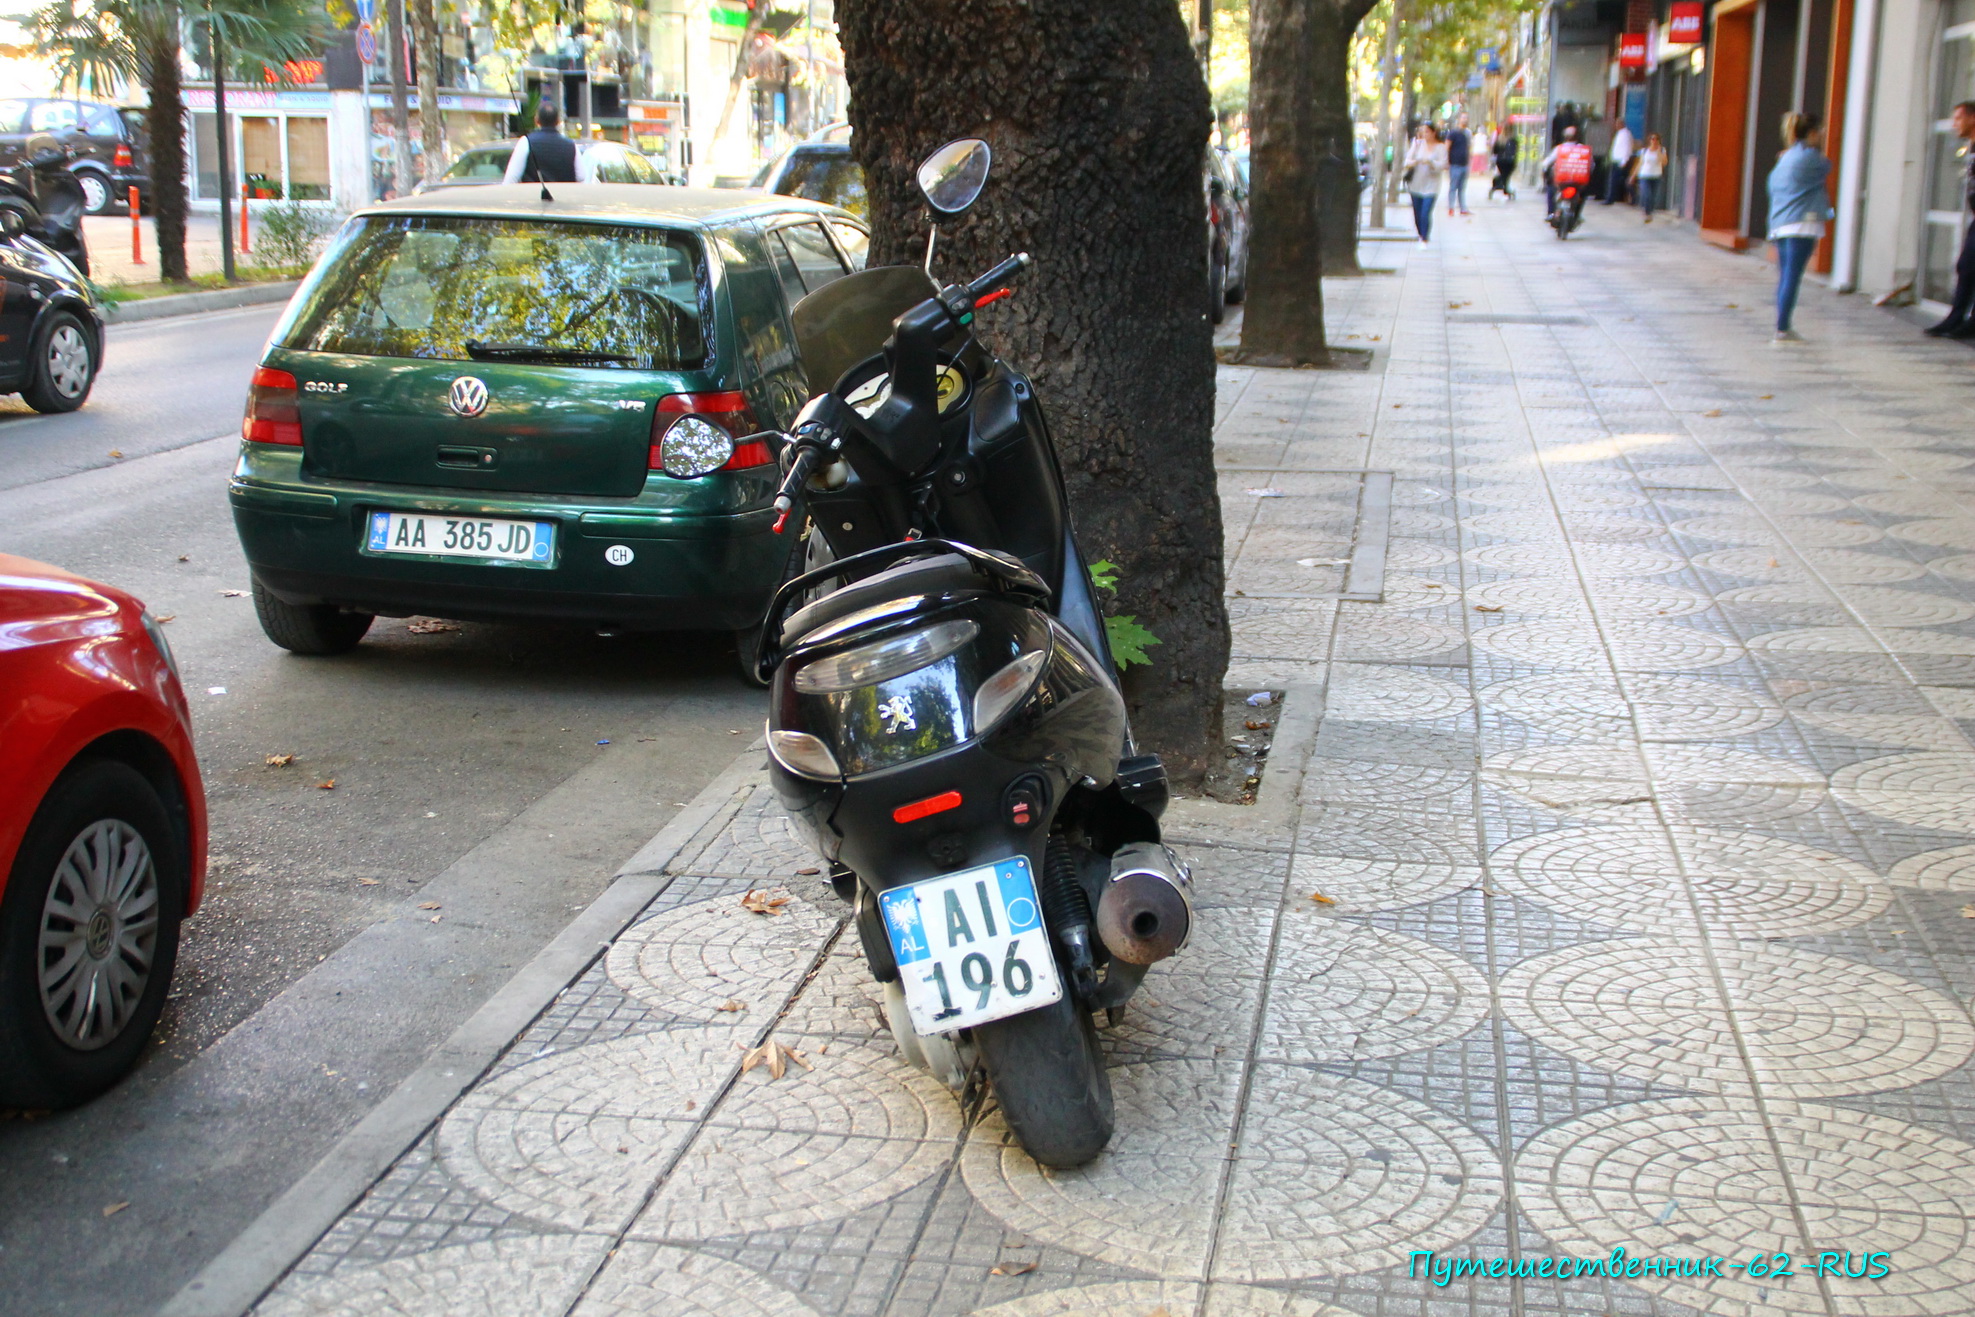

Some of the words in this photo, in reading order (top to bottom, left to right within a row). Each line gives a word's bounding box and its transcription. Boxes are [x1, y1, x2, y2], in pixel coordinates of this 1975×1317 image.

[1671, 16, 1700, 31] ABB
[304, 381, 349, 393] GOLF
[395, 517, 426, 548] AA
[443, 520, 494, 551] 385
[497, 524, 532, 554] JD
[612, 548, 628, 563] CH
[900, 937, 925, 956] AL
[922, 939, 1034, 1022] 196
